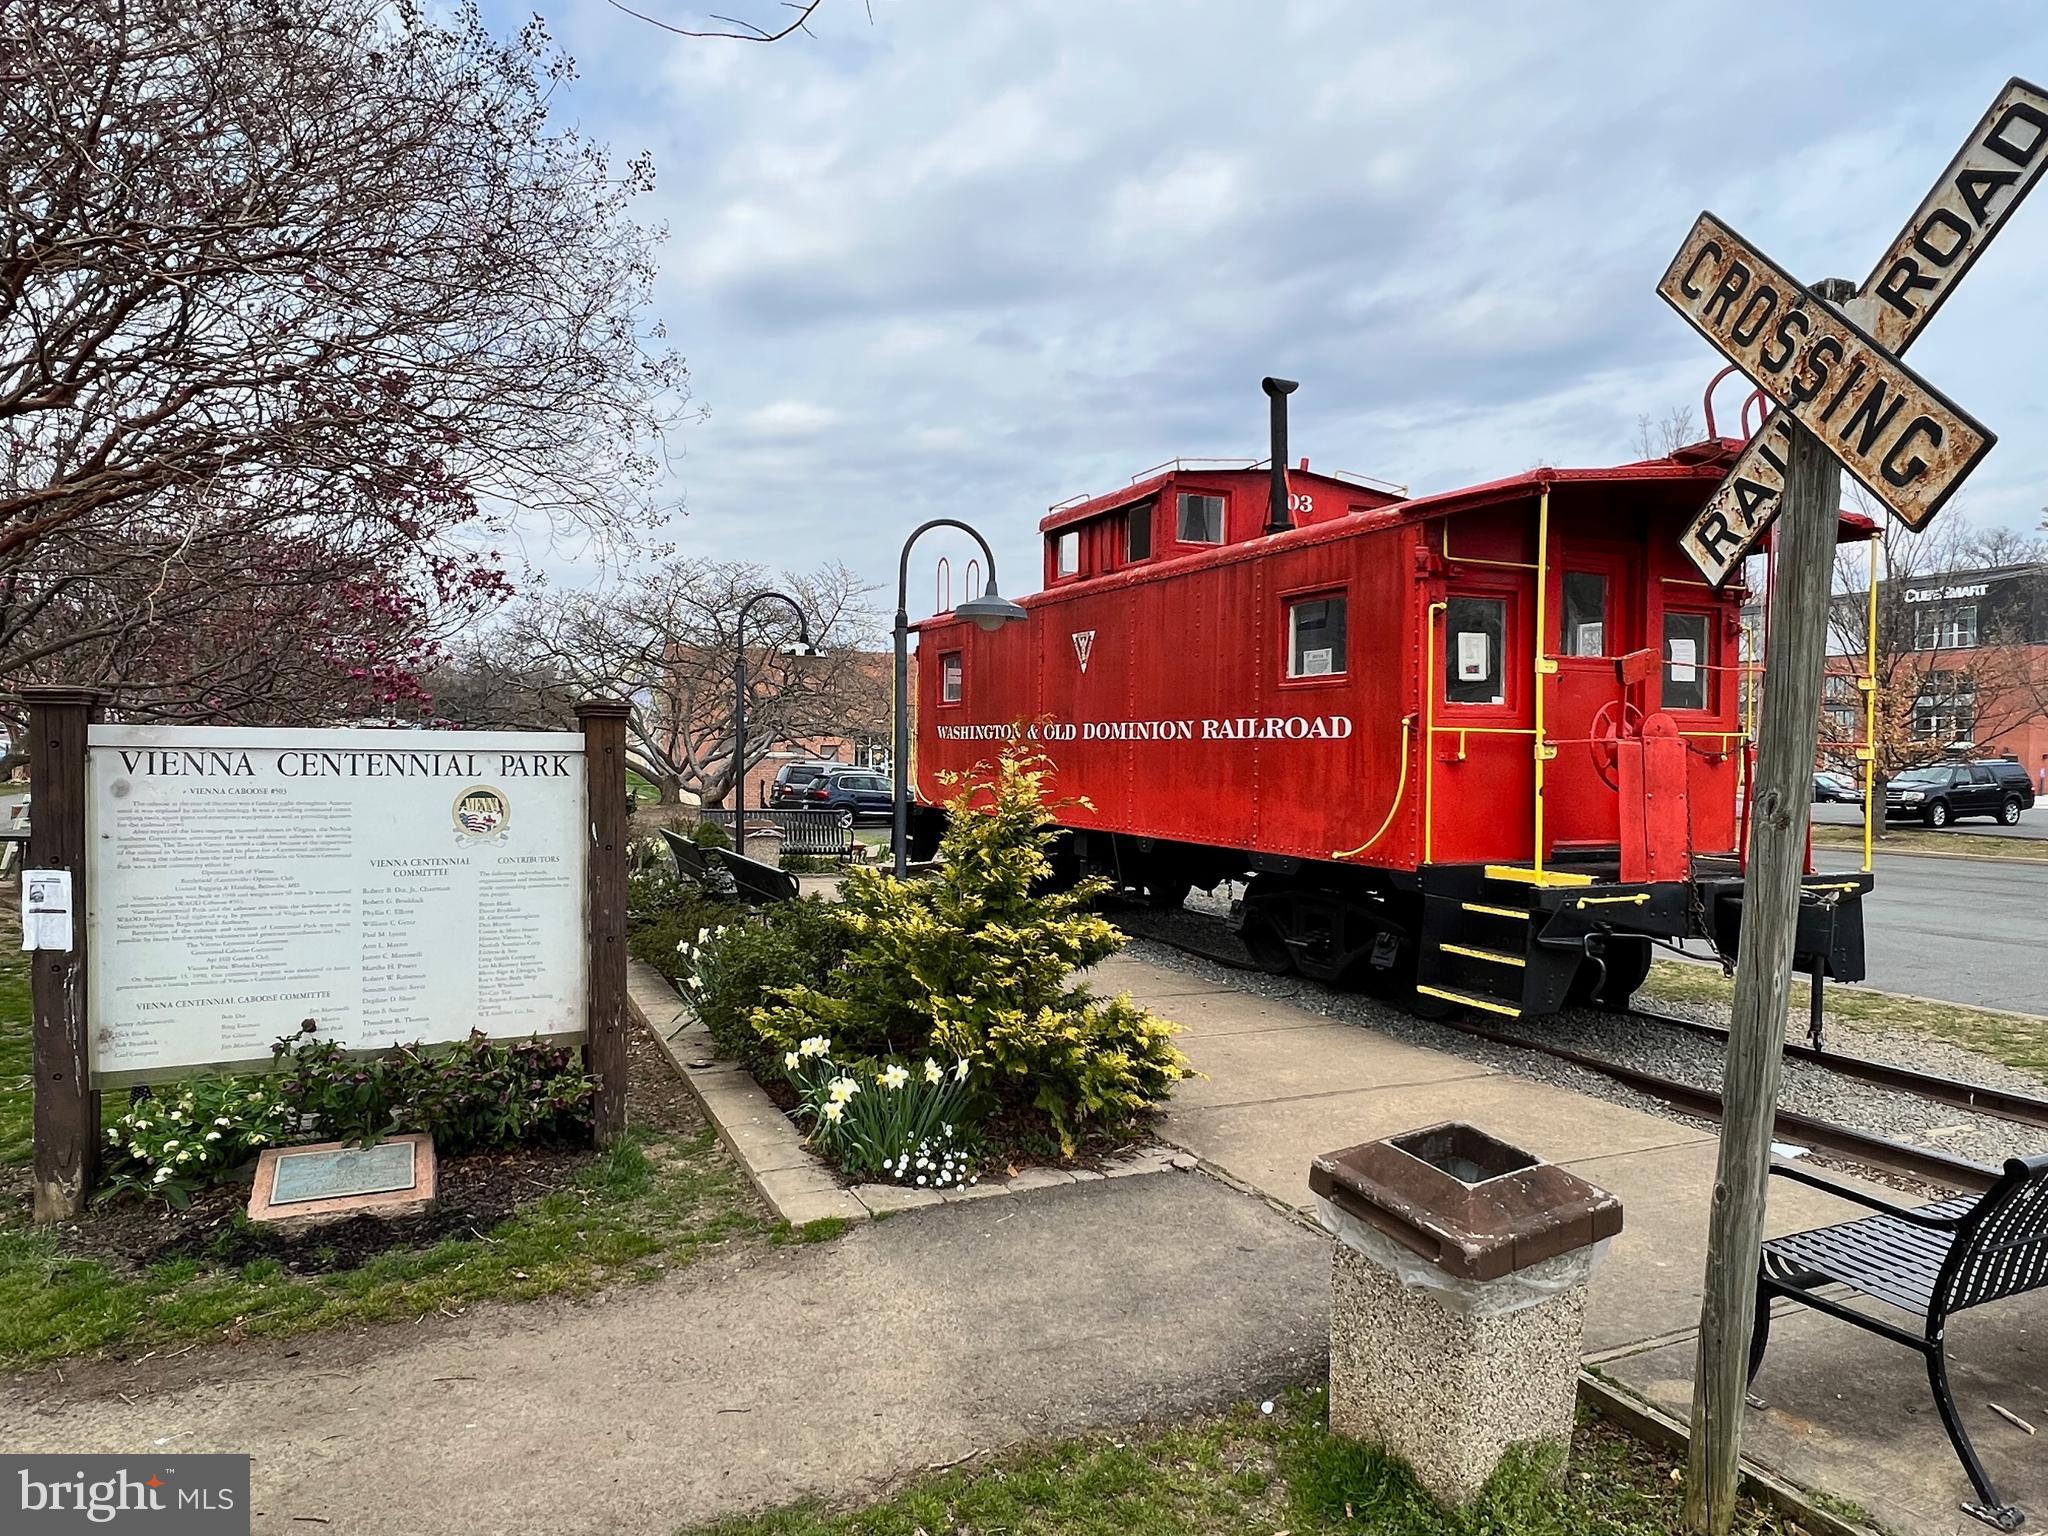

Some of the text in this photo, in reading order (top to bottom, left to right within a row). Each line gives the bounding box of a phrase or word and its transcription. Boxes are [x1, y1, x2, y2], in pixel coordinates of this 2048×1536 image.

[1875, 101, 2048, 319] ROAD
[1681, 241, 1943, 488] CROSSING
[1287, 493, 1313, 513] 03
[936, 716, 1353, 741] WASHINGTON & OLD DOMINION RAILROAD
[118, 749, 572, 778] VIENNA CENTENNIAL PARK
[189, 787, 226, 796] VIENNA
[227, 787, 269, 796] CABOOSE
[370, 857, 471, 868] VIENNA CENTENNIAL
[497, 855, 560, 865] CONTRIBUTORS
[393, 868, 449, 878] COMMITTEE
[136, 990, 331, 1011] VIENNA CENTENNIAL CABOOSE COMMITTEE
